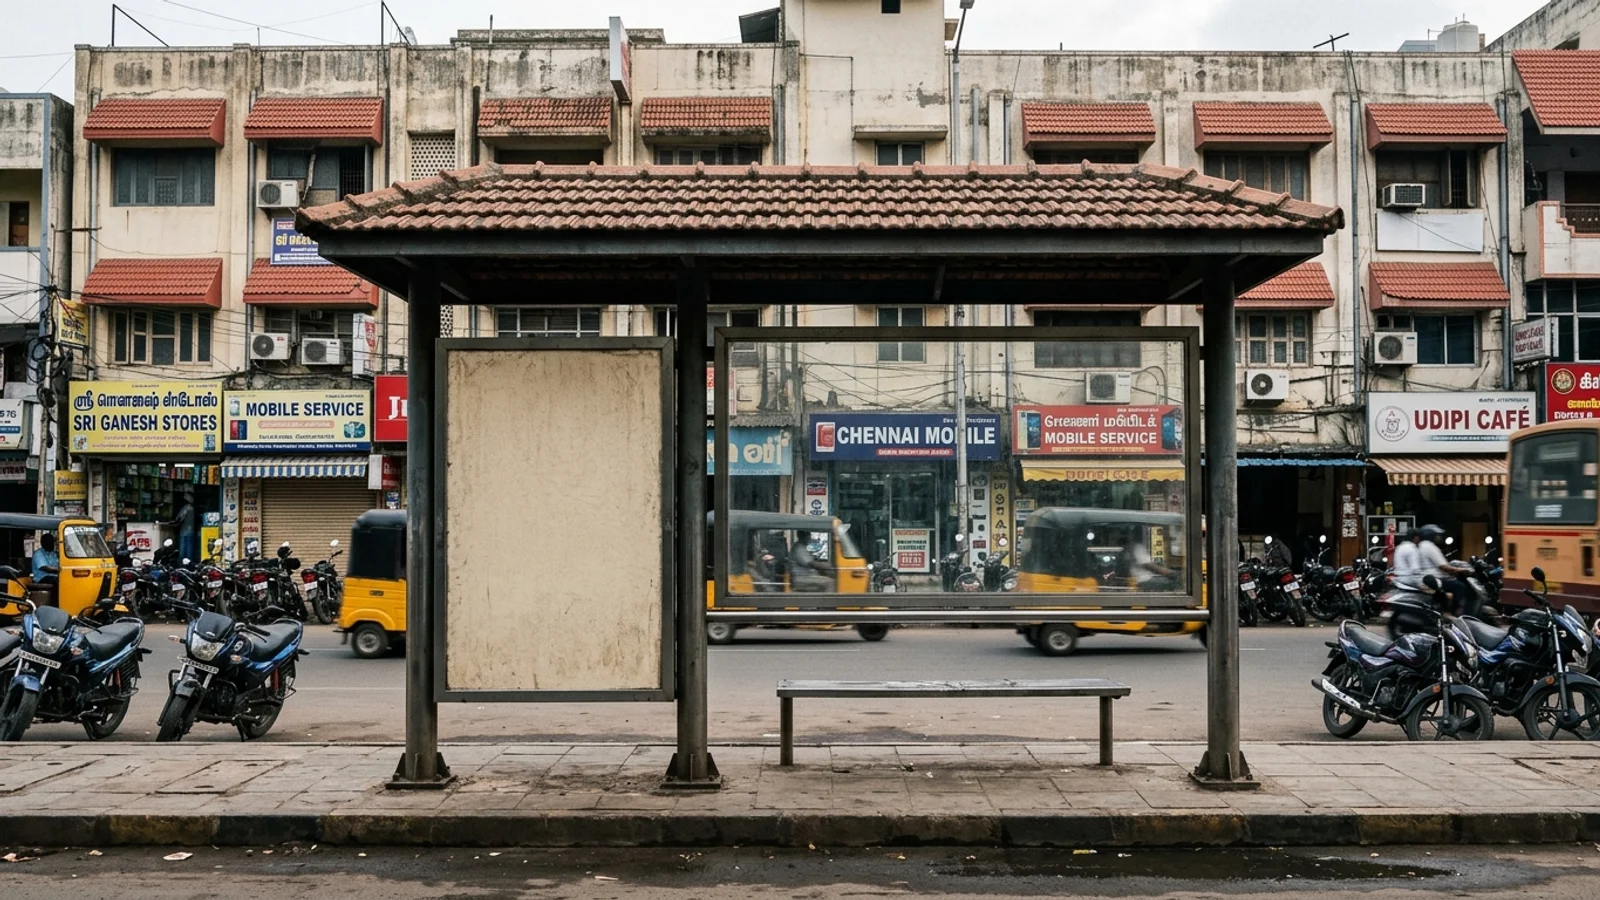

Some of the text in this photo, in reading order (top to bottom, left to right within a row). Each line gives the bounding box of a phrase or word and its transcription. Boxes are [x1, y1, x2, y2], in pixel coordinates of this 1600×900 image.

[246, 402, 364, 417] MOBILE SERVICE
[1414, 405, 1530, 430] UDIPI CAFÉ
[74, 414, 217, 431] SRI GANESH STORES
[836, 426, 996, 445] CHENNAI MOILE
[1045, 432, 1157, 444] MOBILE SERVICE
